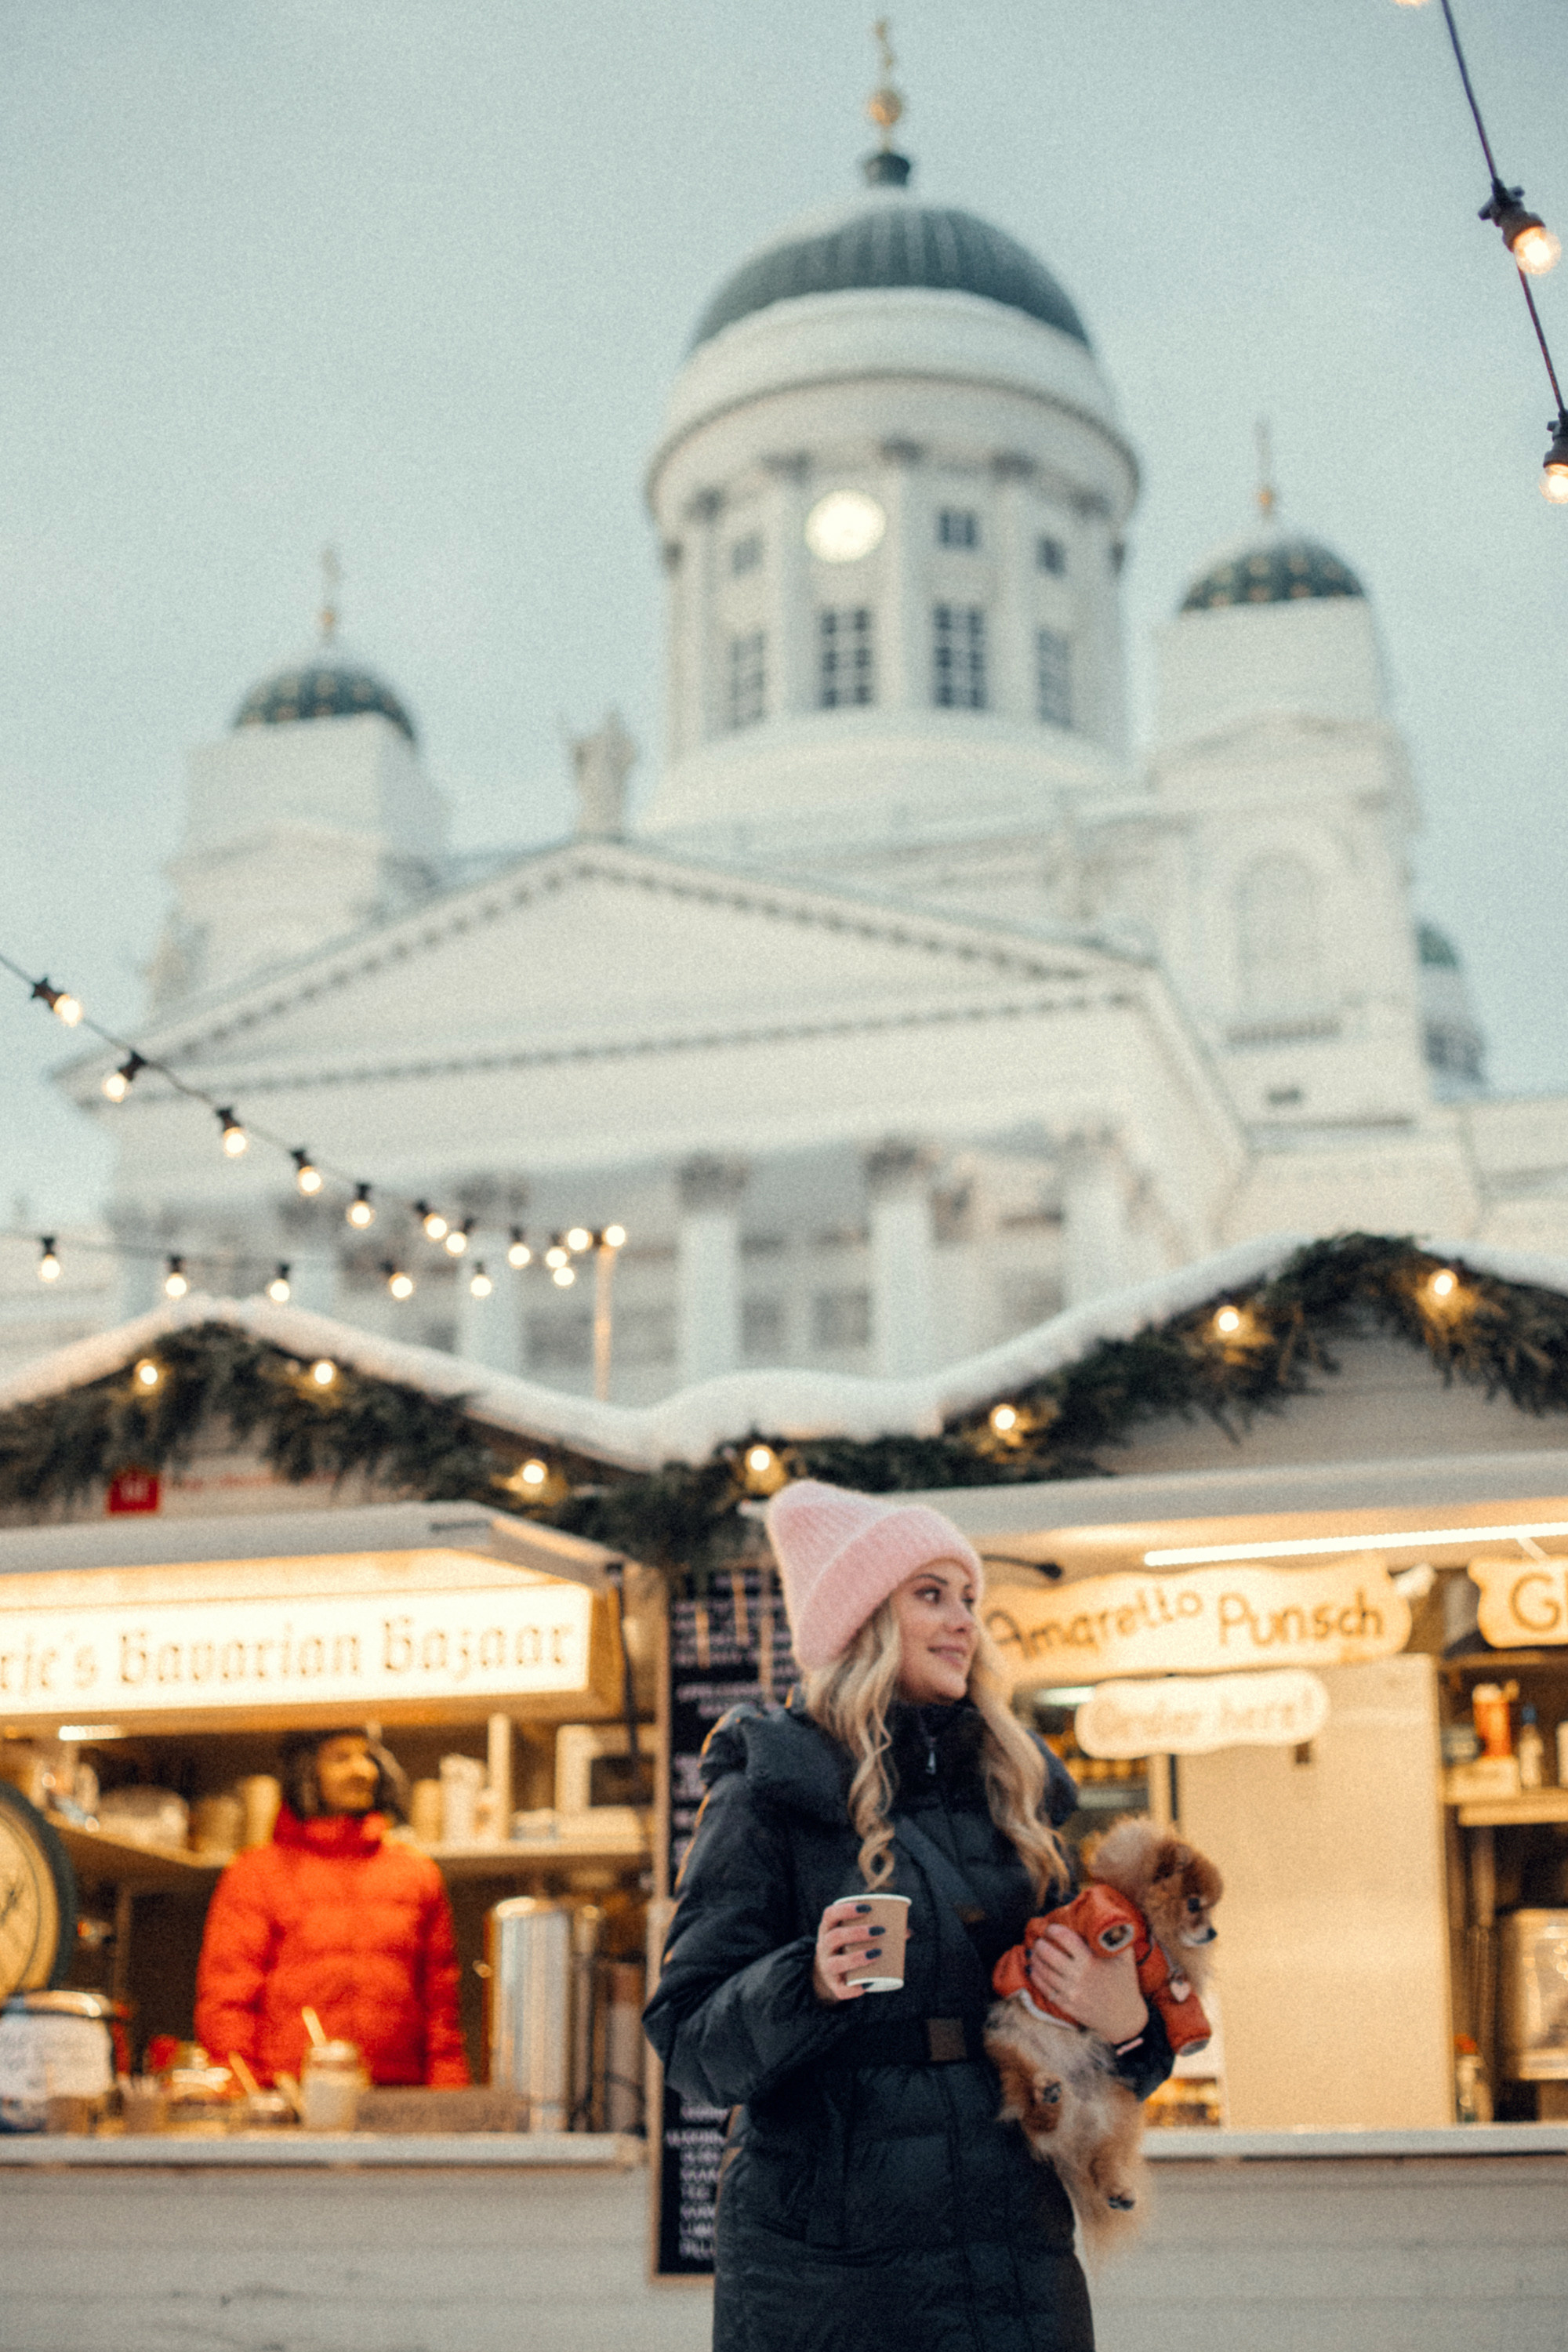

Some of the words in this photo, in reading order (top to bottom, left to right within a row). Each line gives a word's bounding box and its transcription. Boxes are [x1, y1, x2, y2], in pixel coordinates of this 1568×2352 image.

[120, 1624, 362, 1684] Bavarian
[383, 1616, 575, 1681] Bazaar
[1218, 1588, 1385, 1649] Punsch
